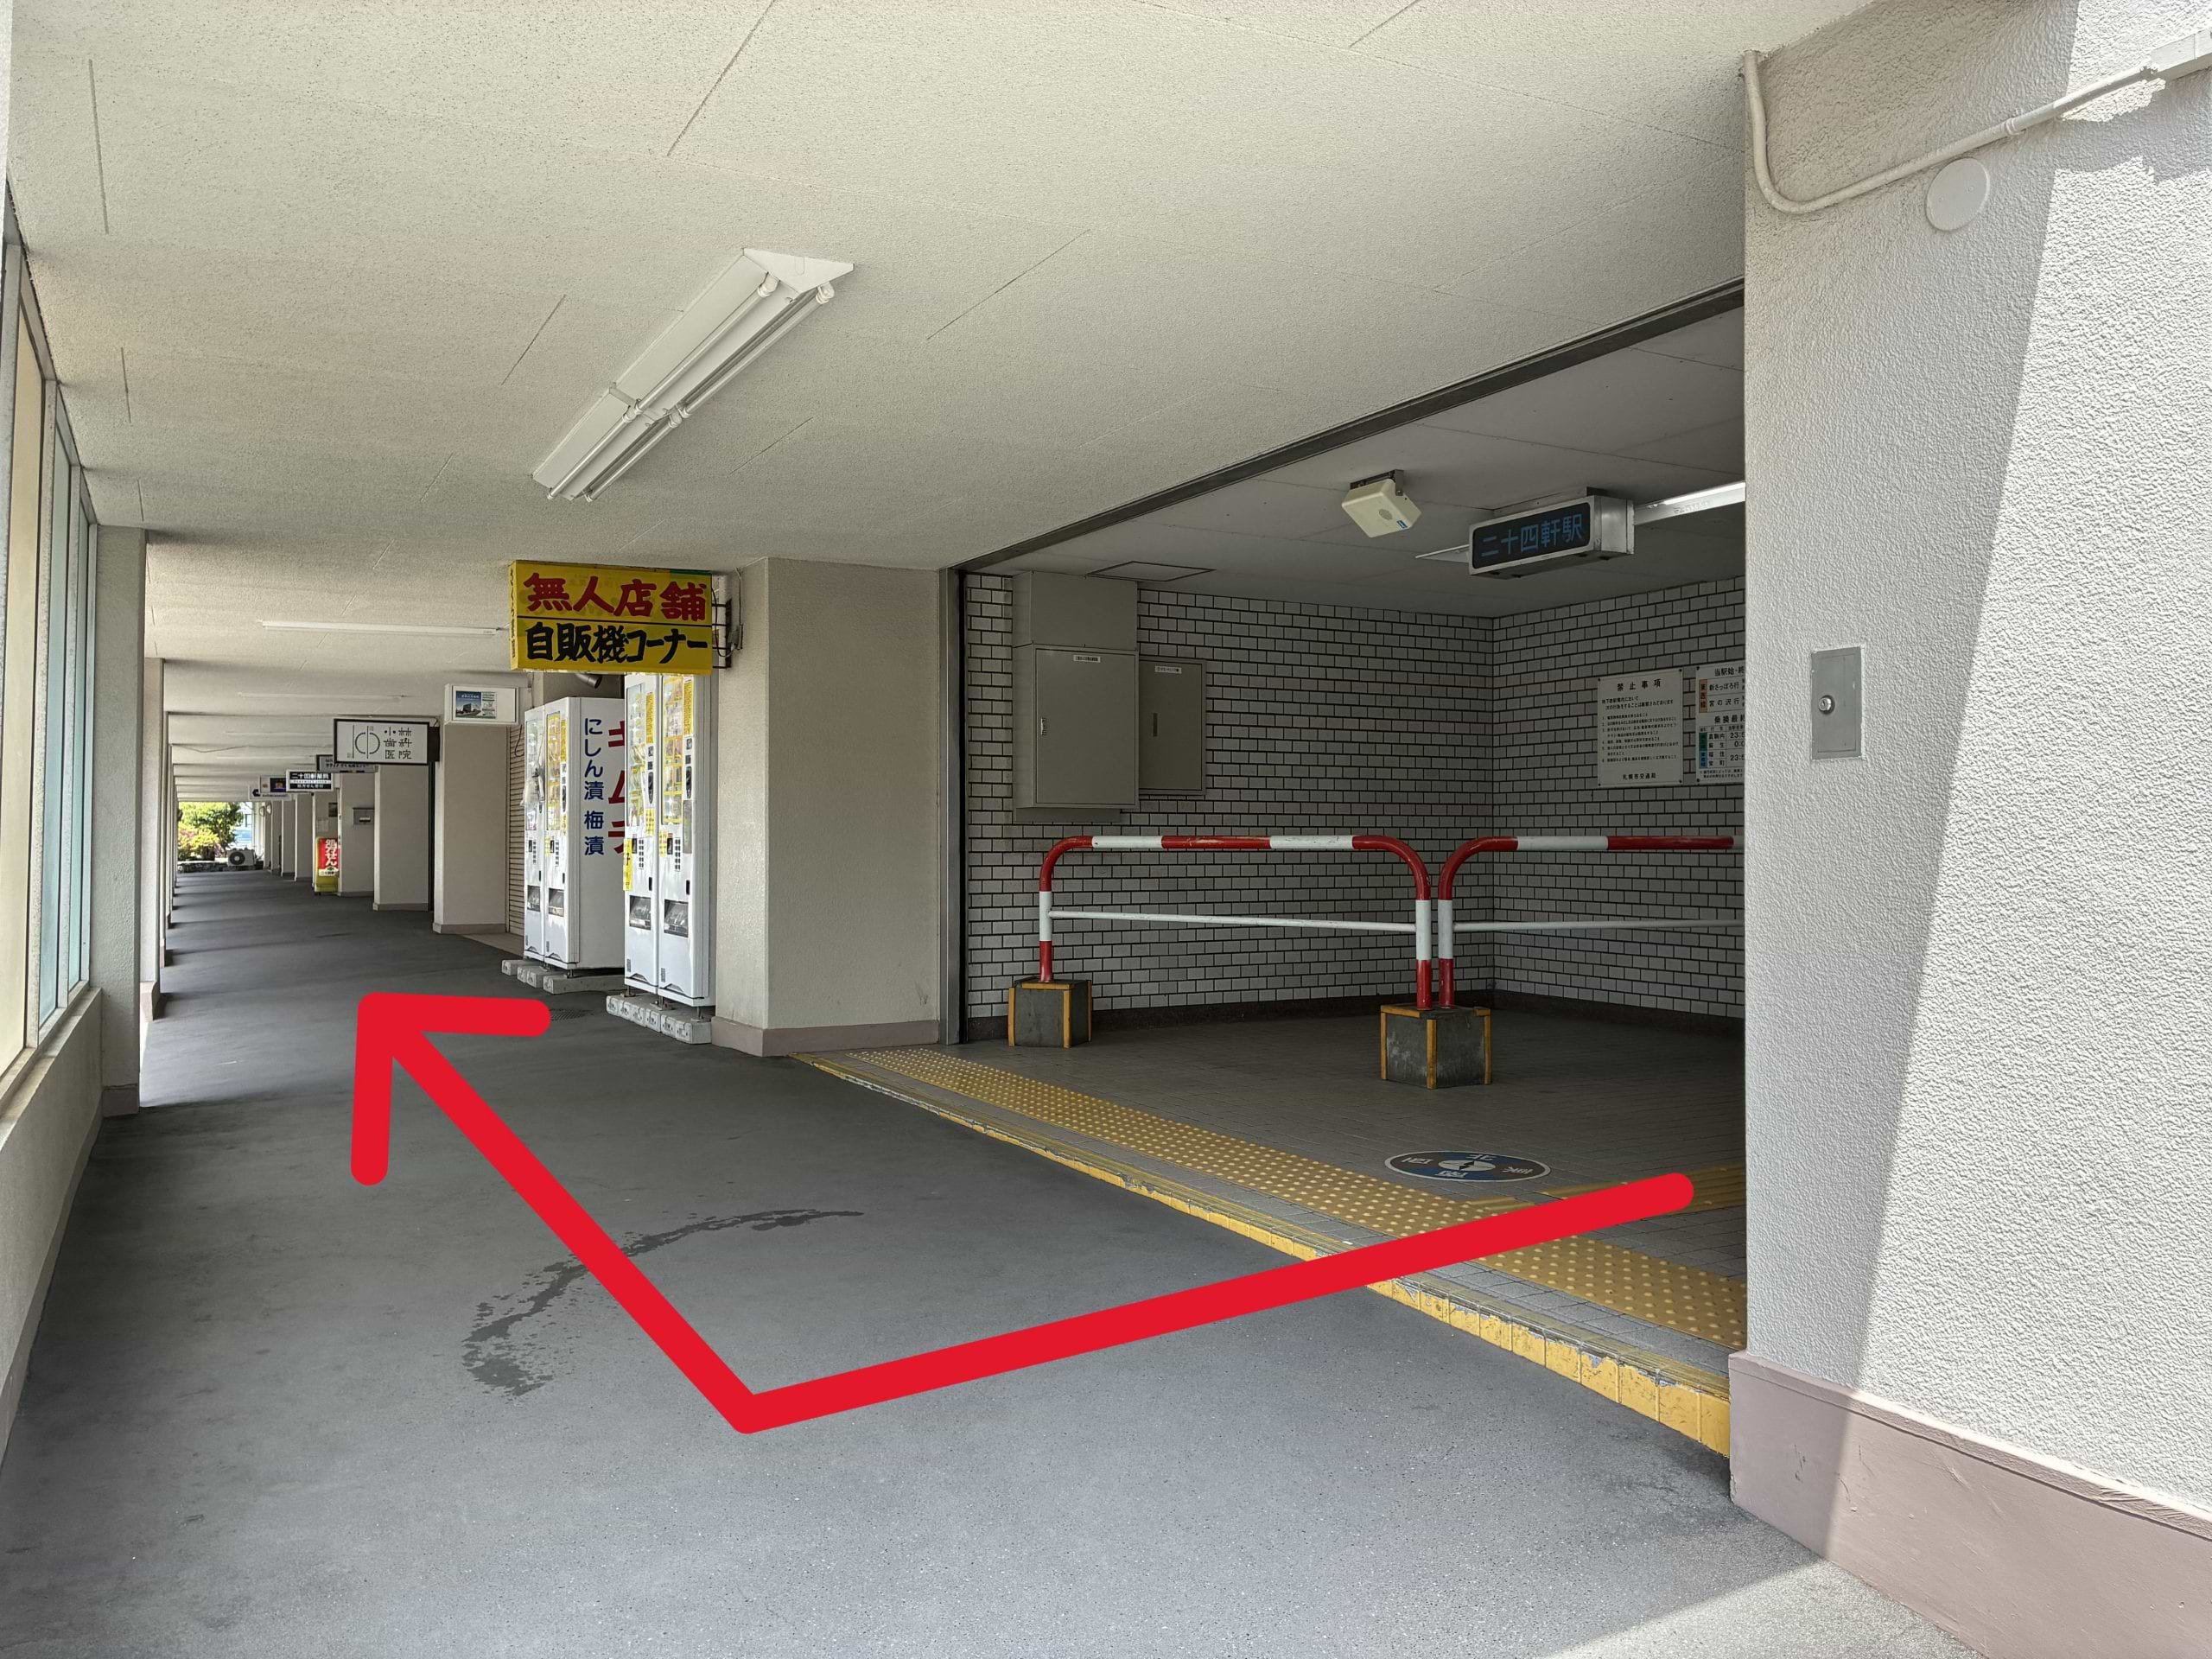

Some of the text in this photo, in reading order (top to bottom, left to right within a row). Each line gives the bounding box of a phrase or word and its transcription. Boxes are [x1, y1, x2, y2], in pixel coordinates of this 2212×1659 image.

[1481, 513, 1583, 557] 二十四軒駅
[523, 572, 707, 621] 無人店舗
[525, 621, 709, 664] 自販機コーナー
[1617, 678, 1661, 691] 禁止事項
[383, 737, 412, 748] 歯科
[384, 726, 412, 737] 小林
[385, 749, 412, 760] 医院
[584, 718, 604, 855] にしん漬 梅漬
[325, 839, 338, 867] 処方せん
